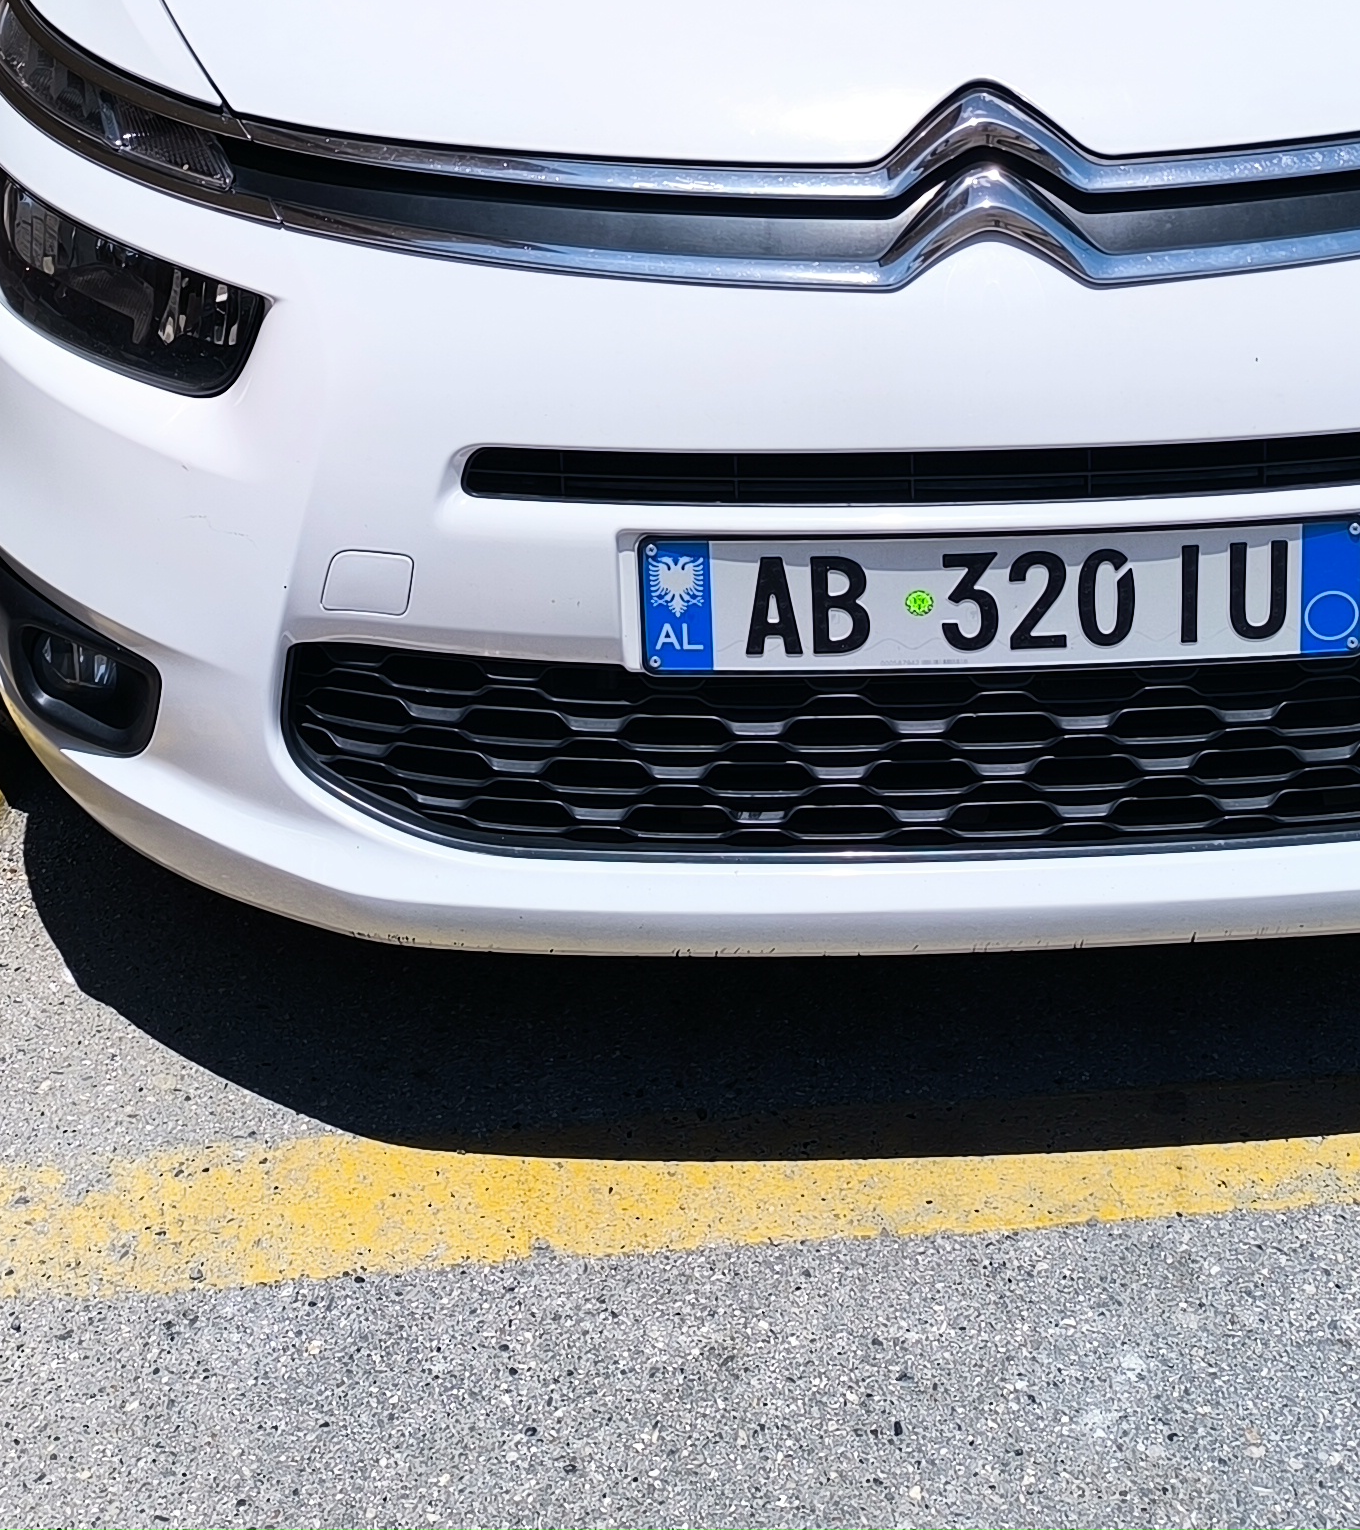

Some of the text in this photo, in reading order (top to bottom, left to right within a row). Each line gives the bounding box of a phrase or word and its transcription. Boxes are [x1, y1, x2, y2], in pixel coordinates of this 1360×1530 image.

[745, 555, 871, 656] AB
[941, 548, 1136, 652] 320
[655, 623, 704, 650] AL
